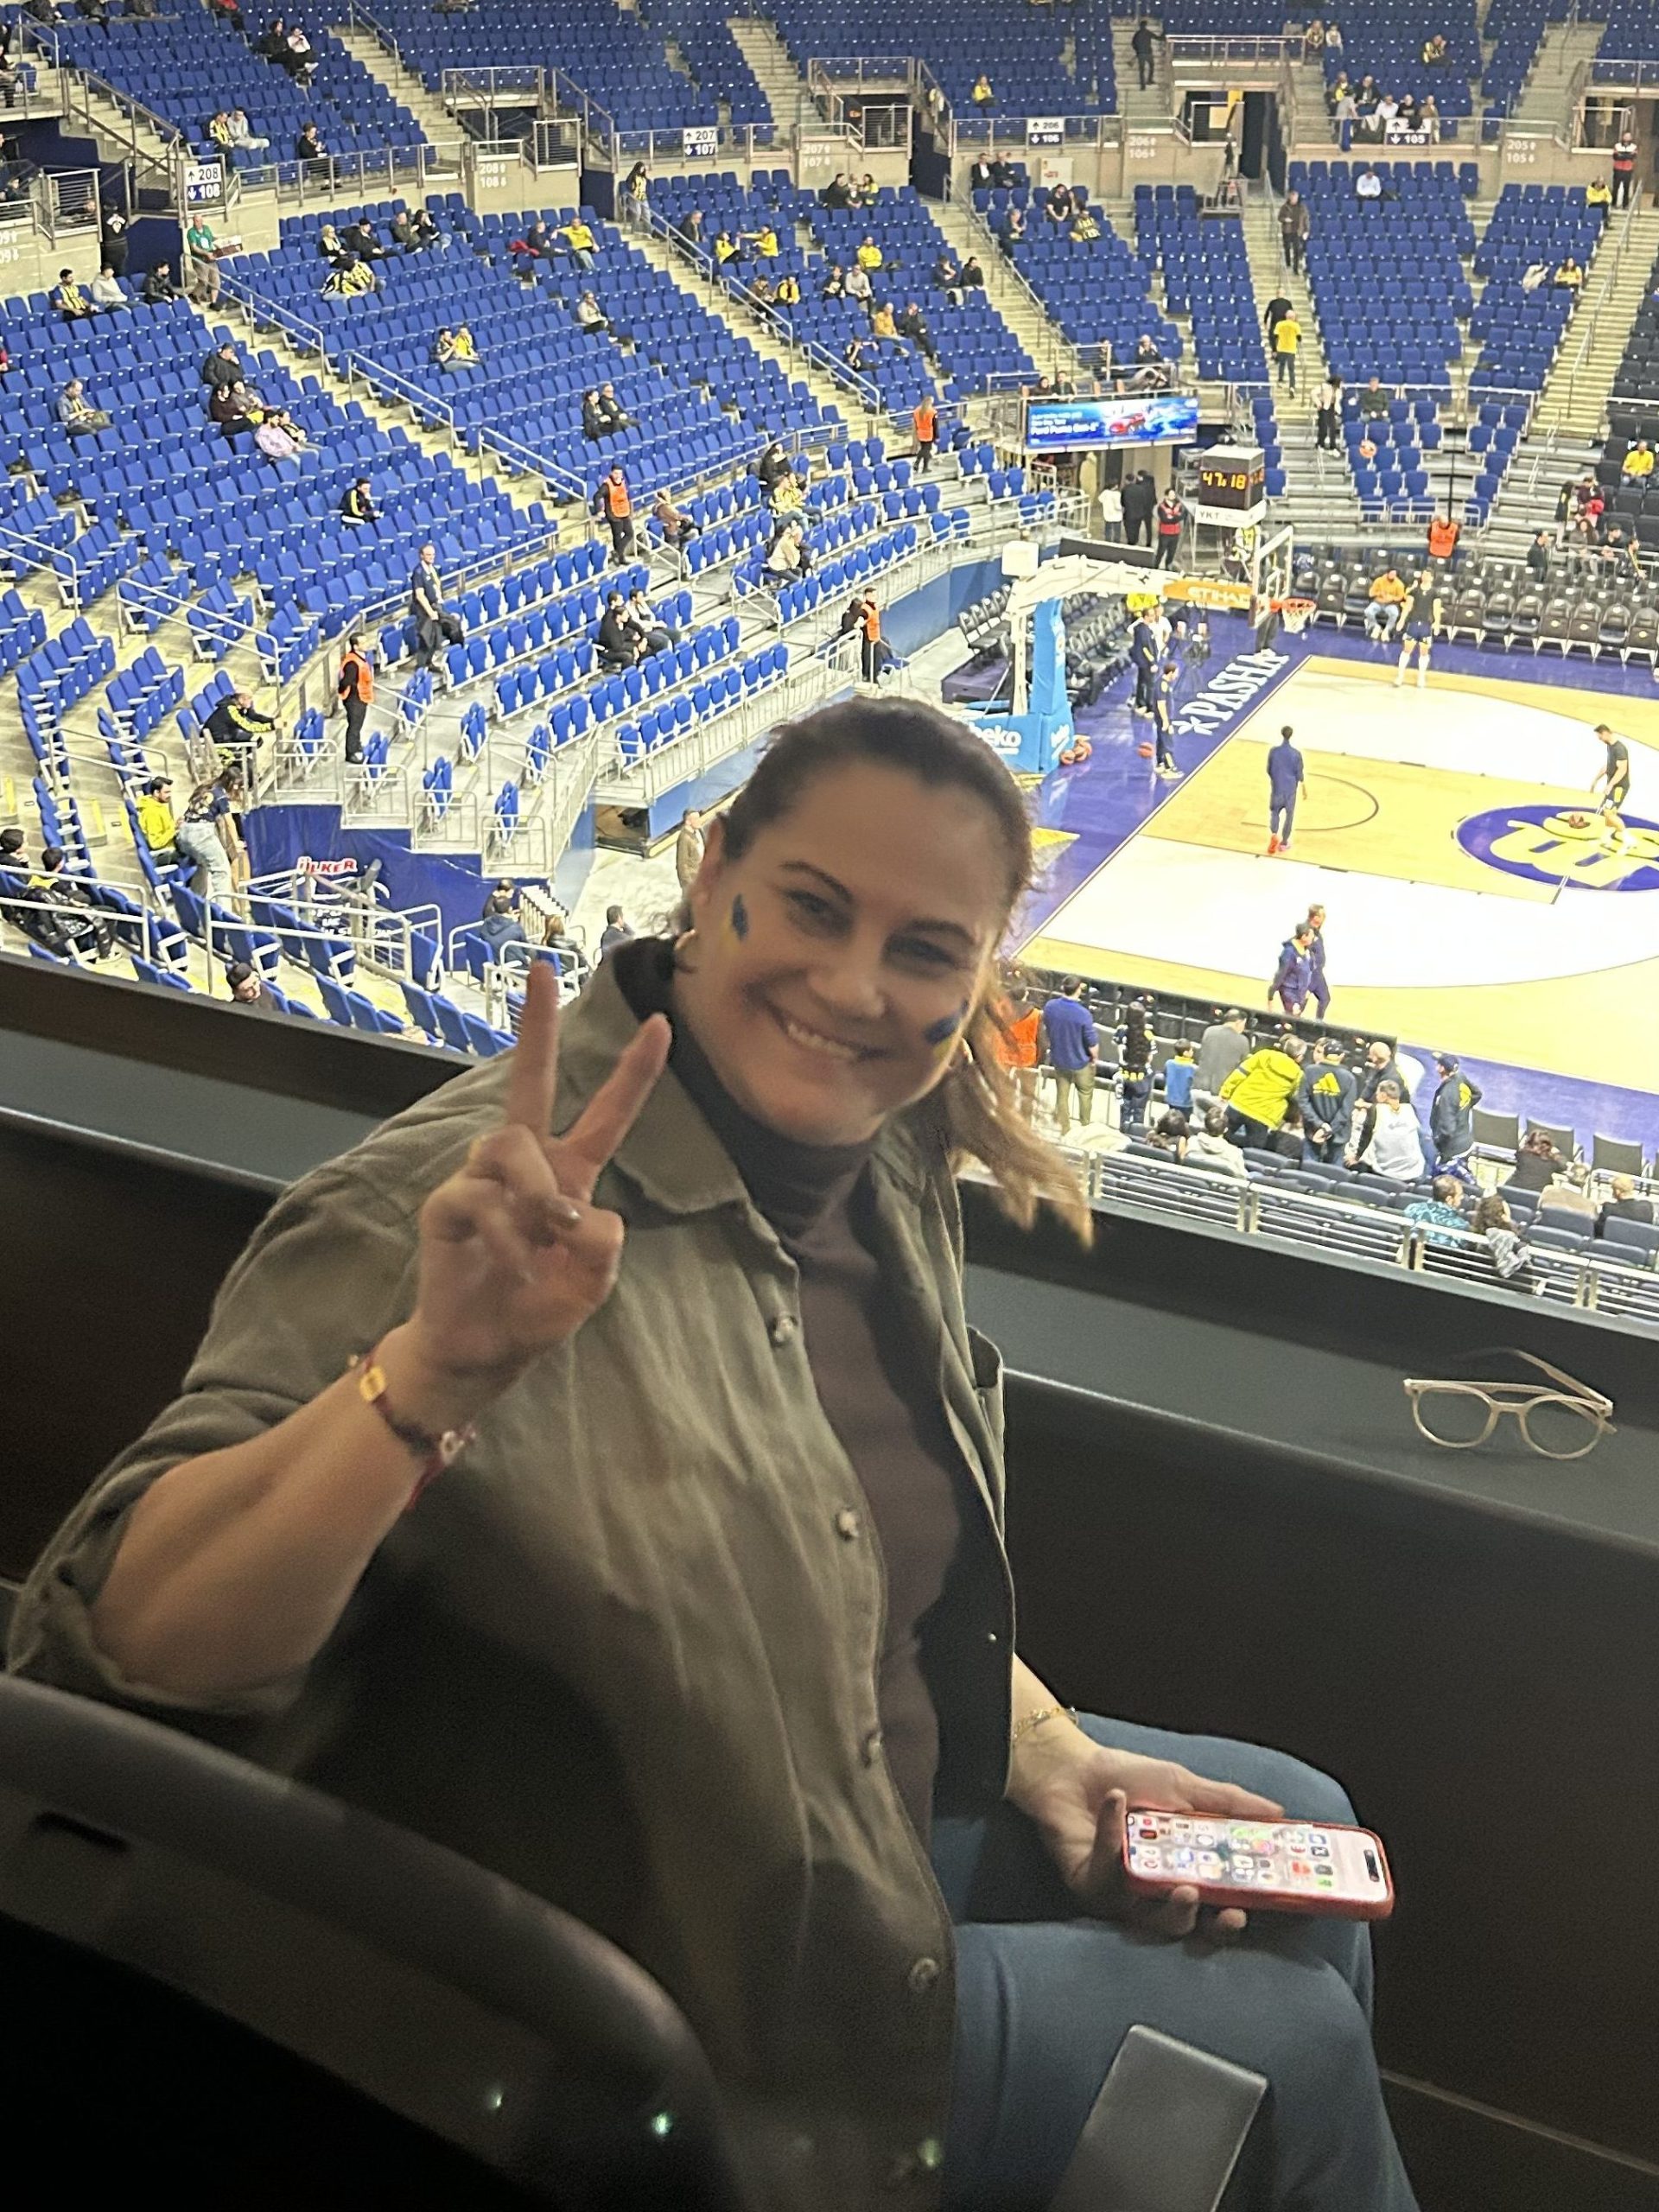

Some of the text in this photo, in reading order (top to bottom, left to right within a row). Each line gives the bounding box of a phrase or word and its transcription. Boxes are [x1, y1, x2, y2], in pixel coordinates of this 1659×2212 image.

[696, 130, 715, 141] 207
[1405, 134, 1426, 144] 105
[695, 143, 715, 156] 107
[199, 167, 219, 181] 208
[199, 183, 220, 199] 108
[1179, 654, 1289, 721] PASHA
